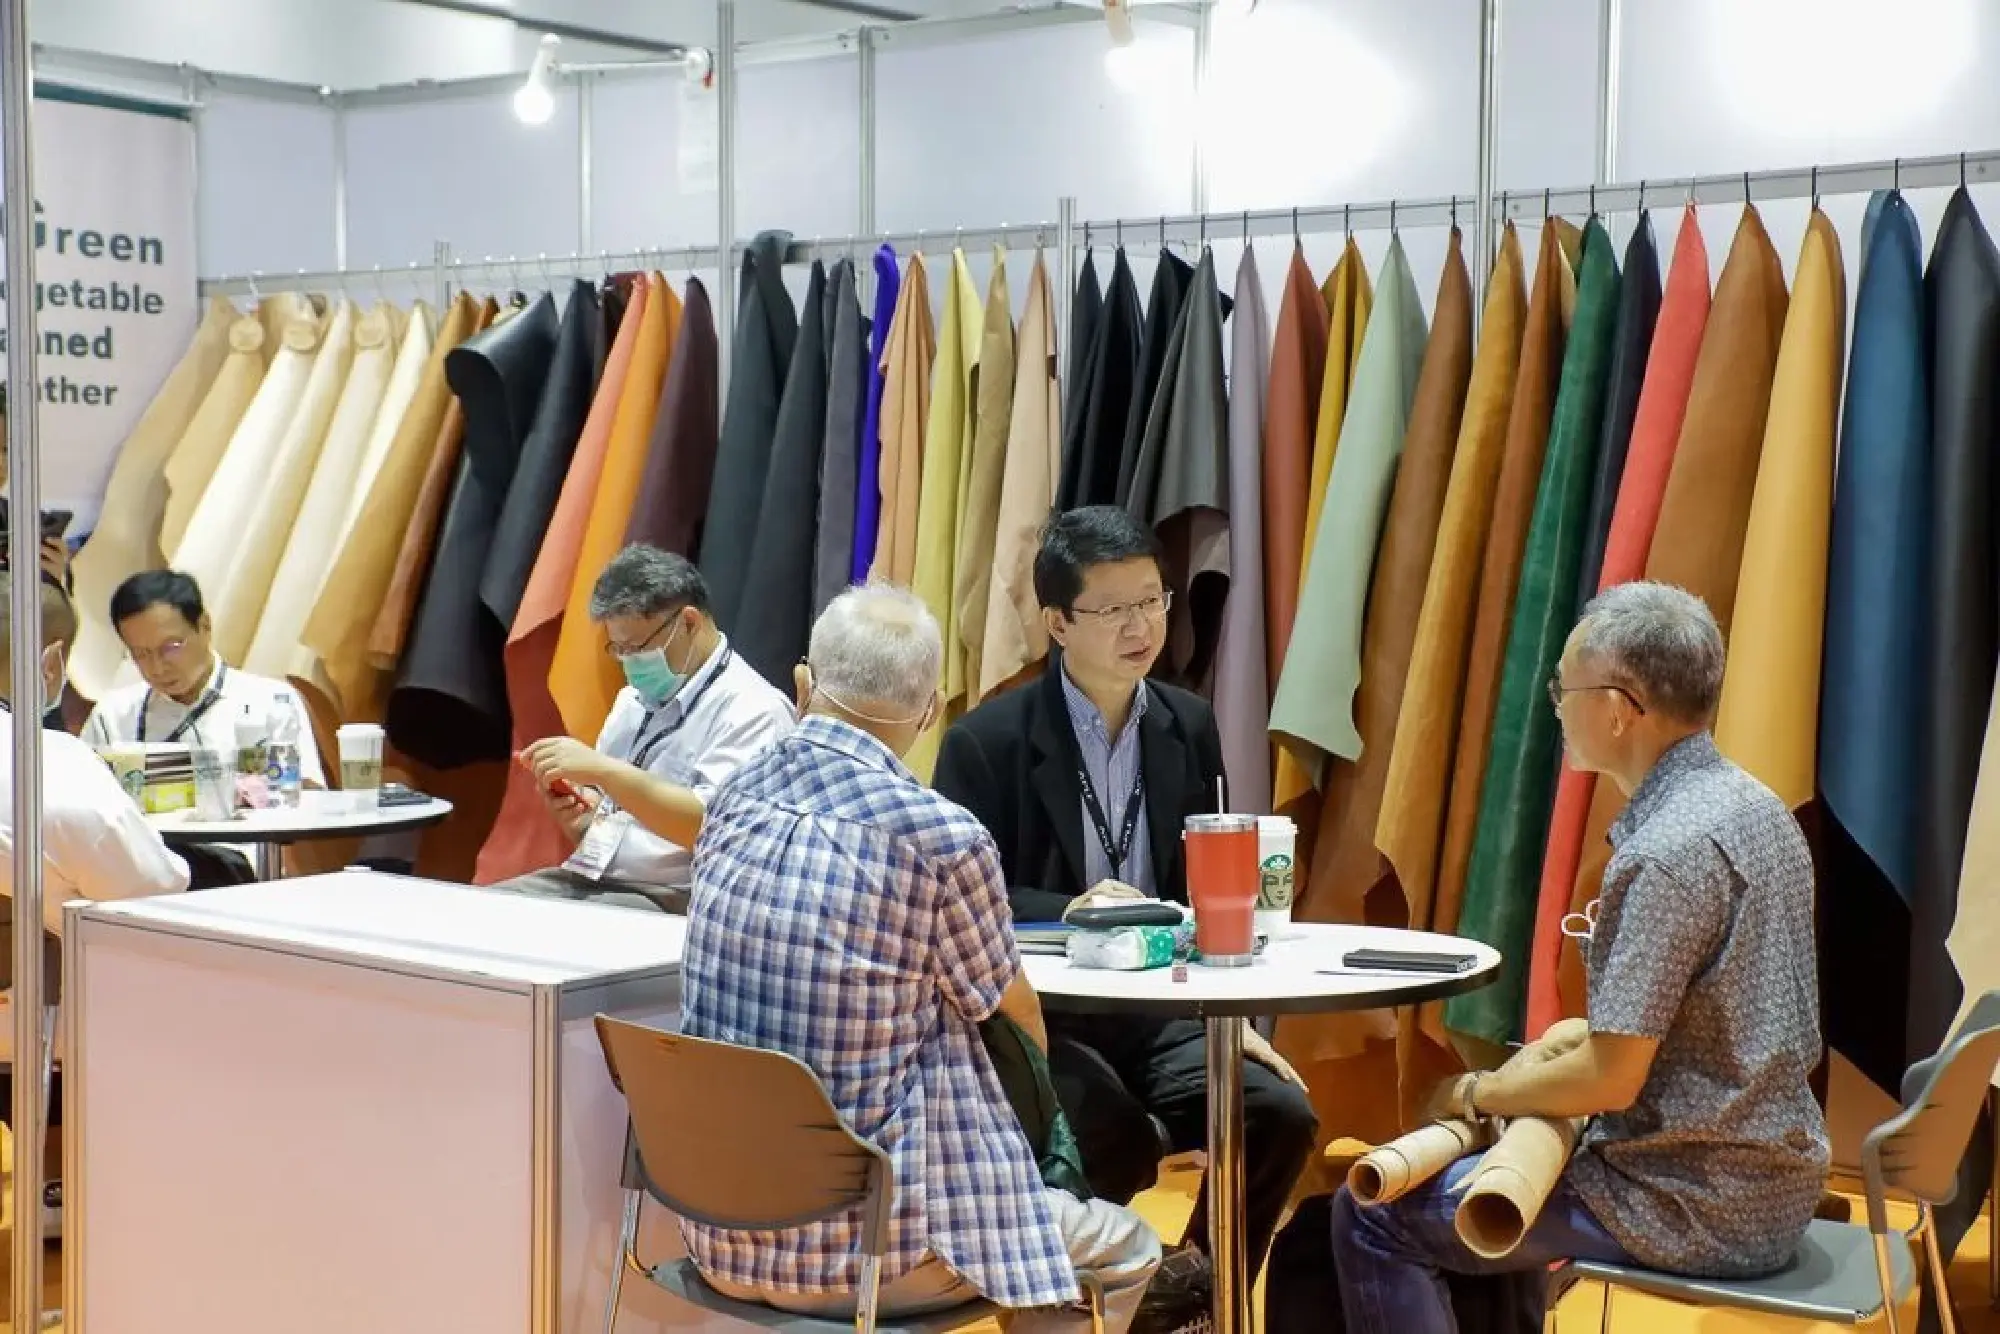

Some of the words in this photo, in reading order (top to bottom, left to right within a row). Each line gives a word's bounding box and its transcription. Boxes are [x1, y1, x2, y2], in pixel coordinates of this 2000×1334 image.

[35, 279, 165, 314] etable
[37, 325, 114, 360] ned
[38, 375, 118, 406] ther
